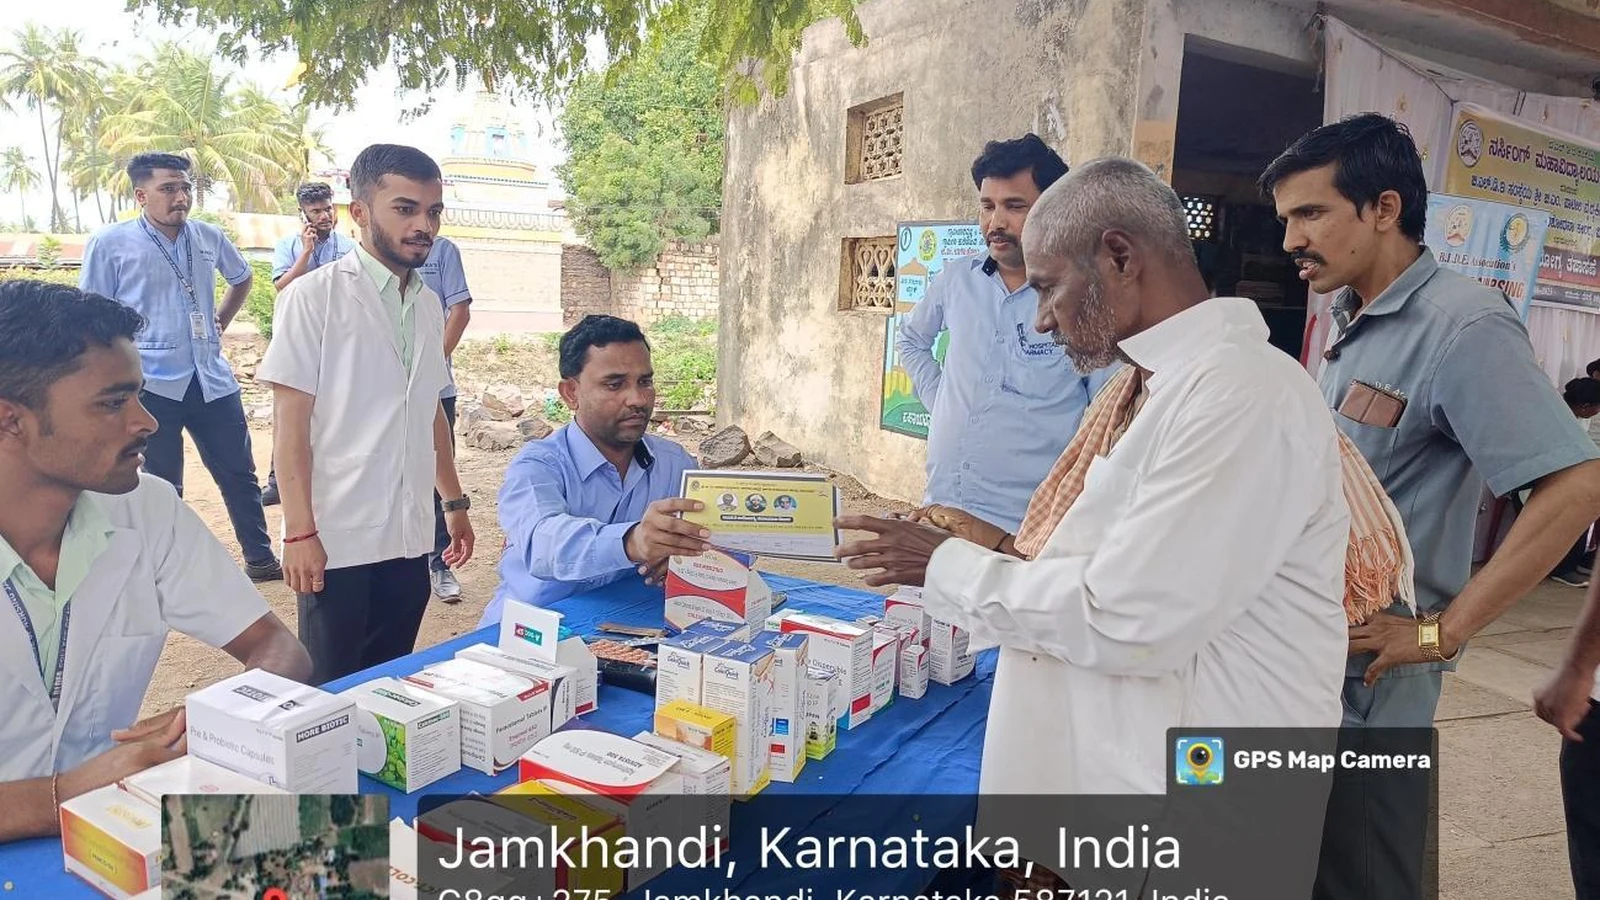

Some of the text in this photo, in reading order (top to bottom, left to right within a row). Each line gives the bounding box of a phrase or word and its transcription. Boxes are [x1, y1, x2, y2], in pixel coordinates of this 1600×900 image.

[297, 728, 320, 742] MORE
[321, 715, 349, 732] BIOTIC
[190, 726, 202, 738] Pre
[203, 731, 208, 740] &
[209, 732, 240, 752] Probiotic
[241, 745, 275, 765] Capsules
